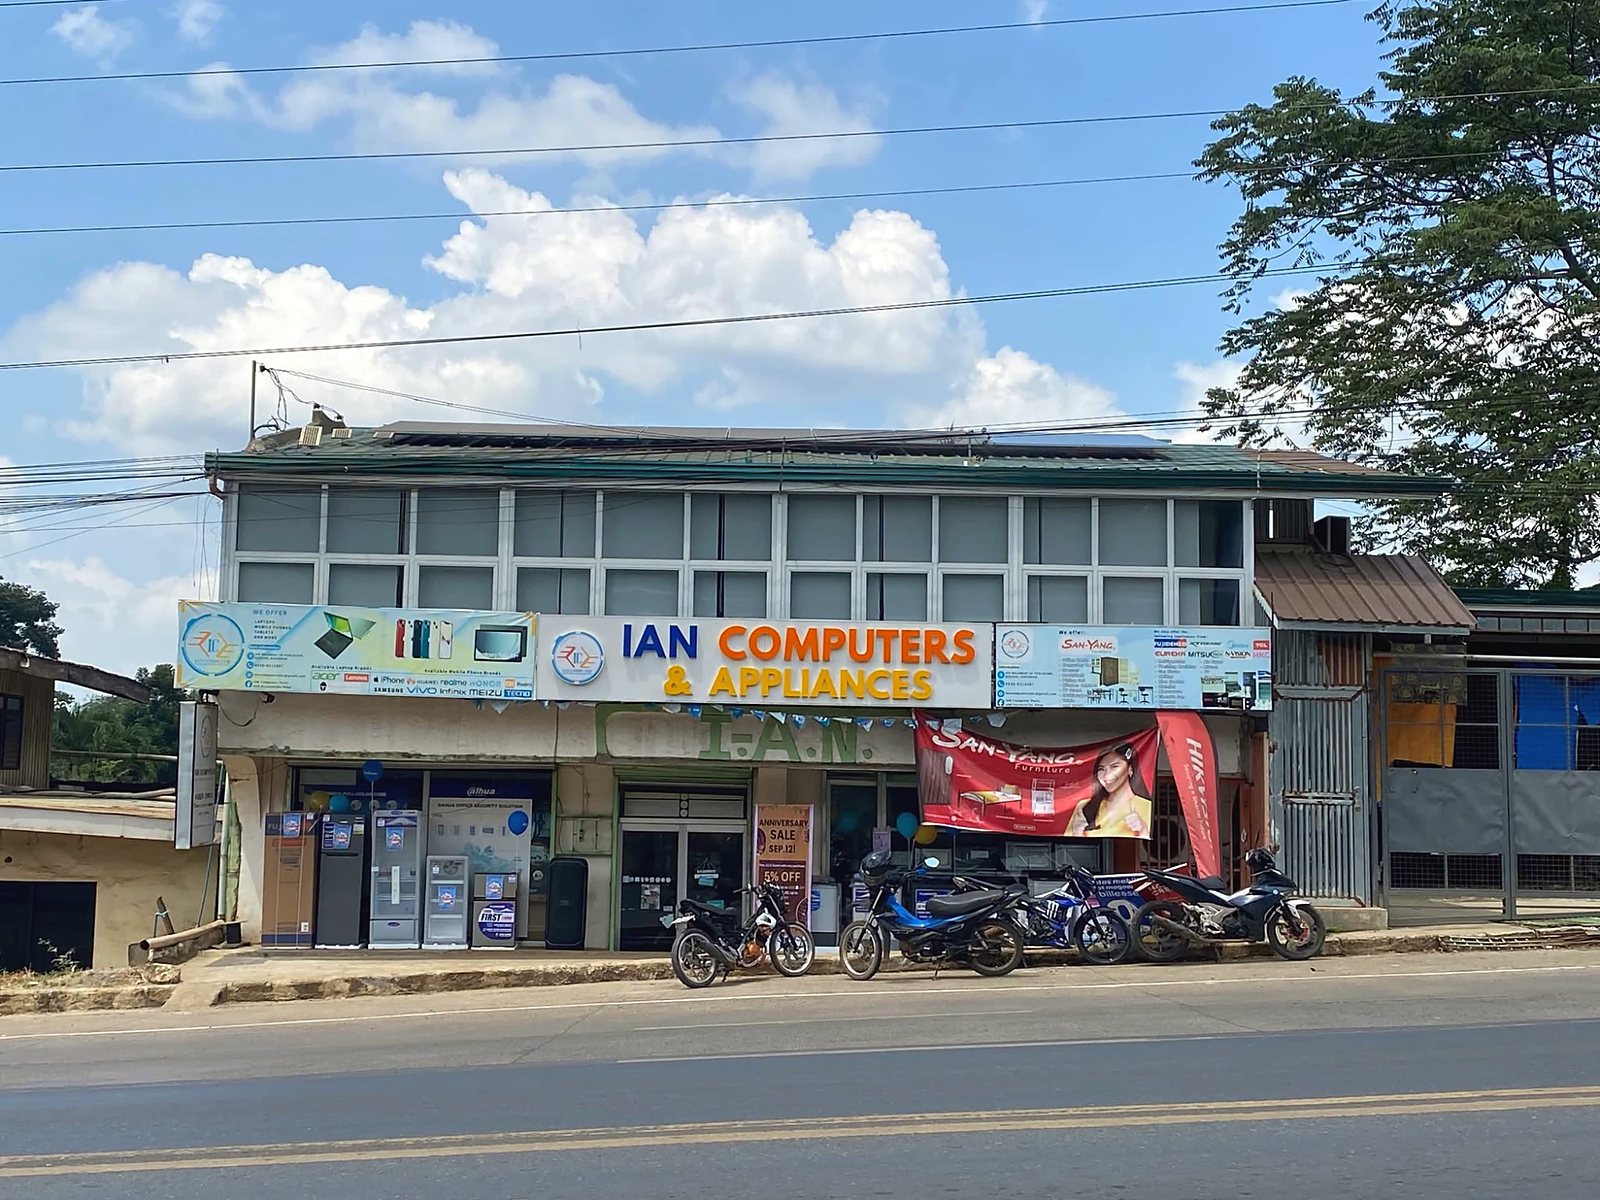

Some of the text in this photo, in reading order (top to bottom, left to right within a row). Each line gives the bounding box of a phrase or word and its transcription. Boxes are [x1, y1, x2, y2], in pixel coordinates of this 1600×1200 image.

[623, 624, 976, 665] IAN COMPUTERS
[312, 672, 340, 680] acer
[381, 676, 405, 684] iPhone
[663, 665, 933, 700] & APPLIANCES
[406, 685, 437, 694] vivo
[470, 688, 502, 697] MEIZU
[1014, 763, 1071, 774] Furniture
[760, 818, 808, 827] ANNIVERSARY
[770, 829, 796, 840] SALE
[764, 871, 800, 882] 5% OFF
[481, 914, 502, 922] FIRST
